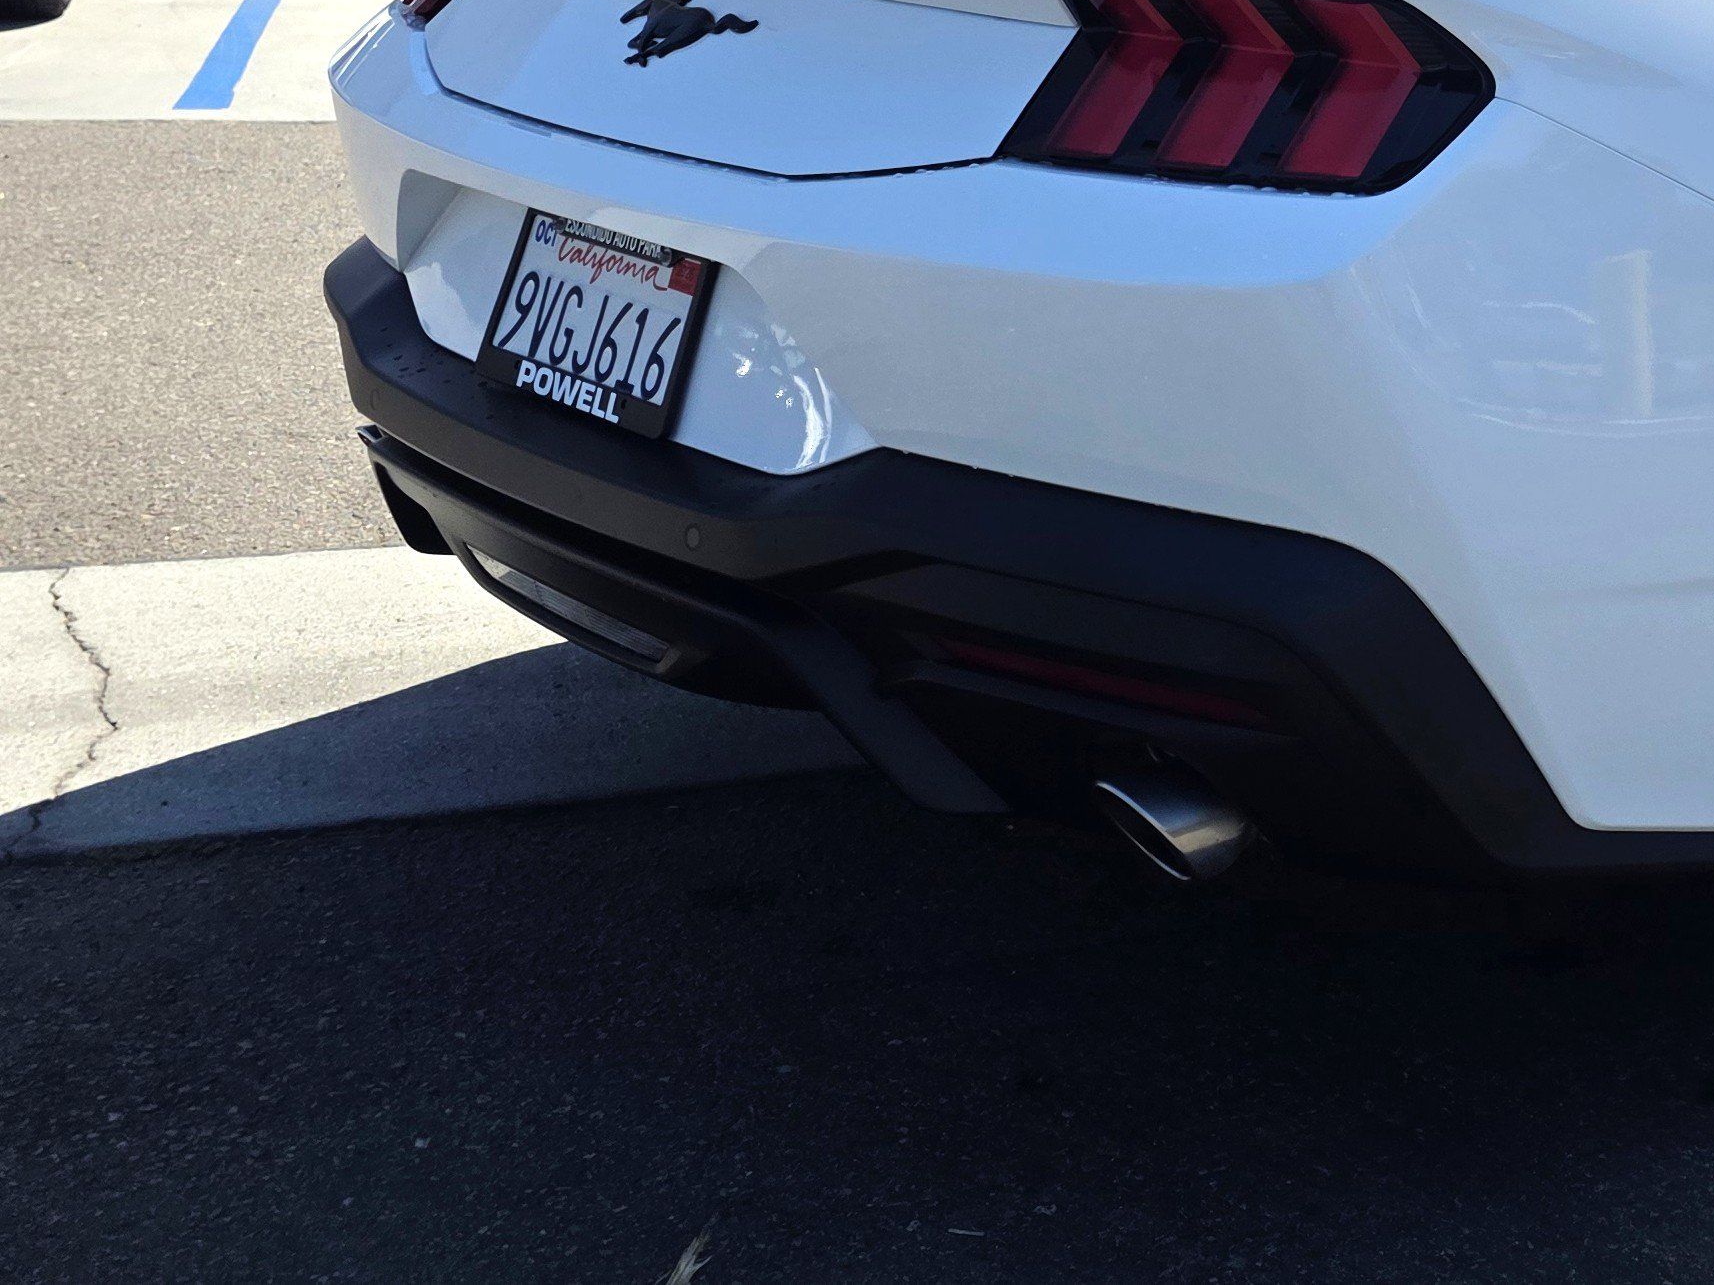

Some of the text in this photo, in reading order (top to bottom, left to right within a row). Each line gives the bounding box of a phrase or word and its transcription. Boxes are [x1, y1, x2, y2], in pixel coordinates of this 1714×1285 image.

[558, 235, 668, 292] California
[565, 217, 613, 245] ESCONDIDO
[614, 231, 636, 251] AUTO
[497, 270, 682, 400] 9VGJ616
[515, 359, 620, 424] POWELL
